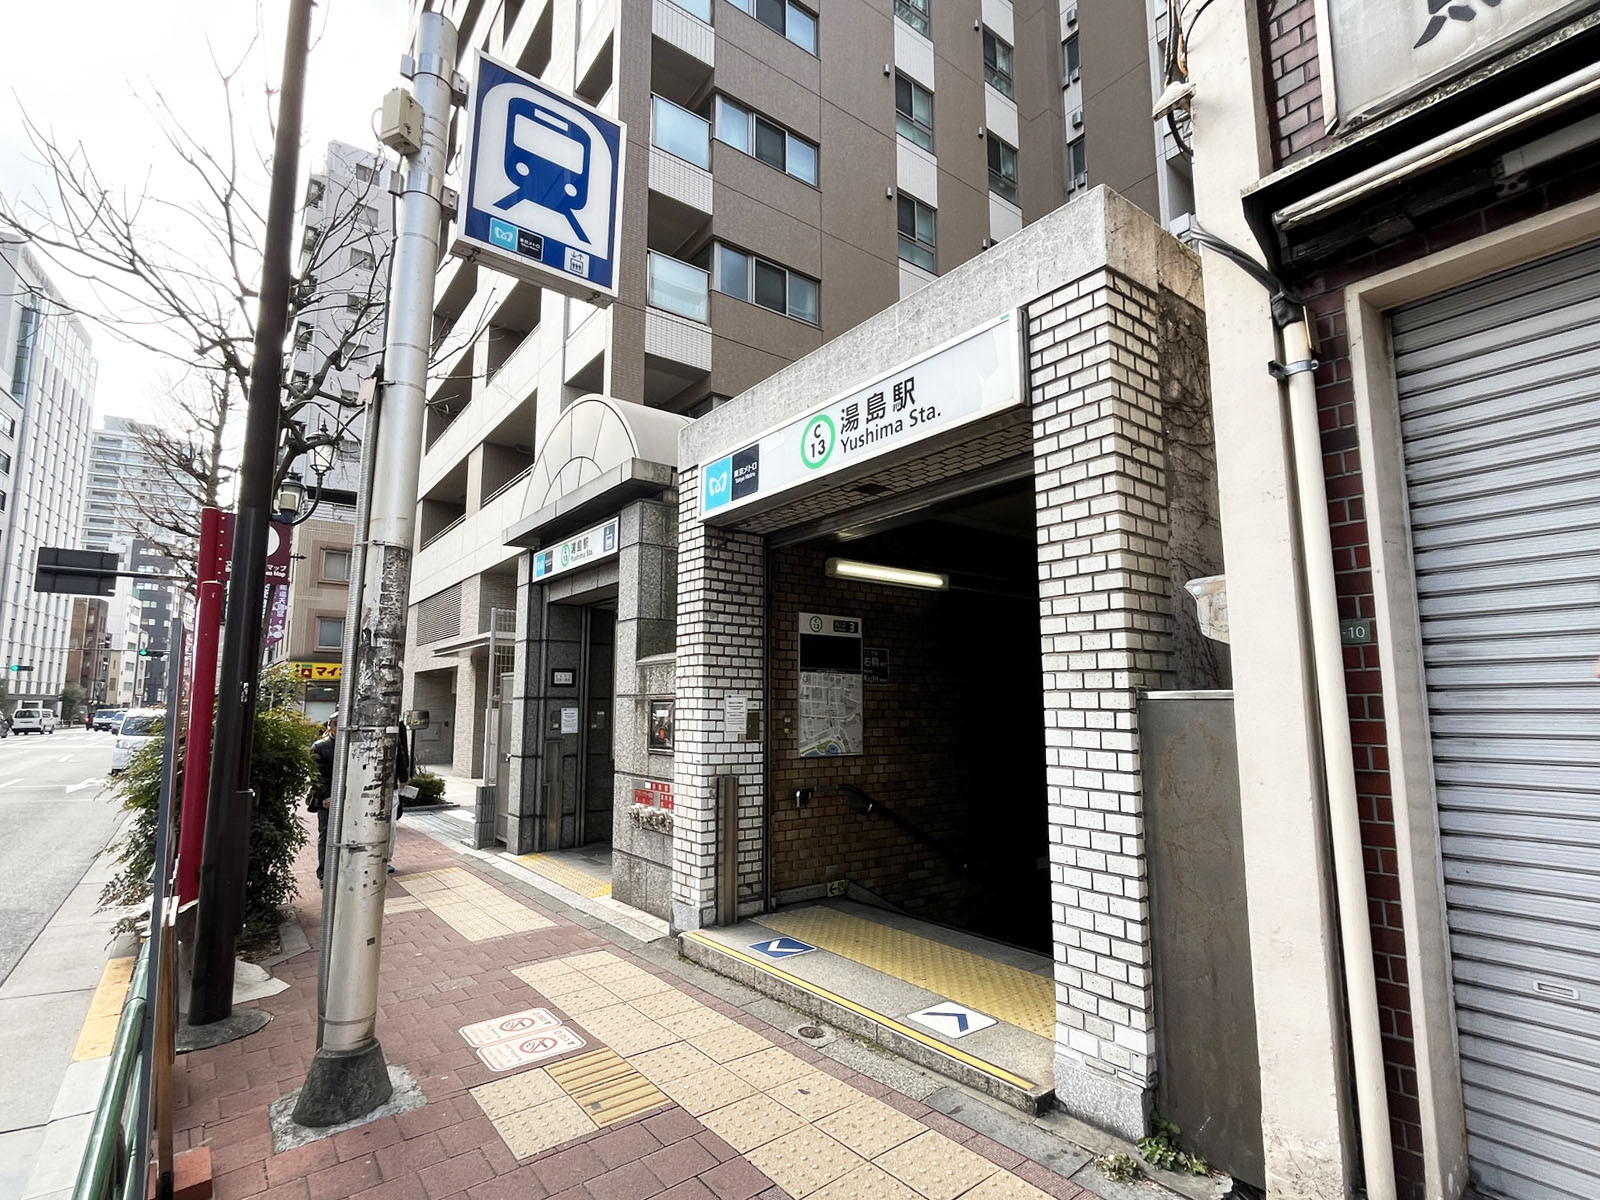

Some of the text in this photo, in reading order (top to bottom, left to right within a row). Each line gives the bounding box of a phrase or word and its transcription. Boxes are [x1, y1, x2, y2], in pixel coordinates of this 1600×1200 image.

[840, 376, 916, 435] 湯島駅
[813, 424, 822, 439] C
[840, 405, 942, 455] Yushima Sta.
[810, 440, 827, 458] 13
[848, 622, 856, 633] 3
[315, 666, 342, 677] マイ
